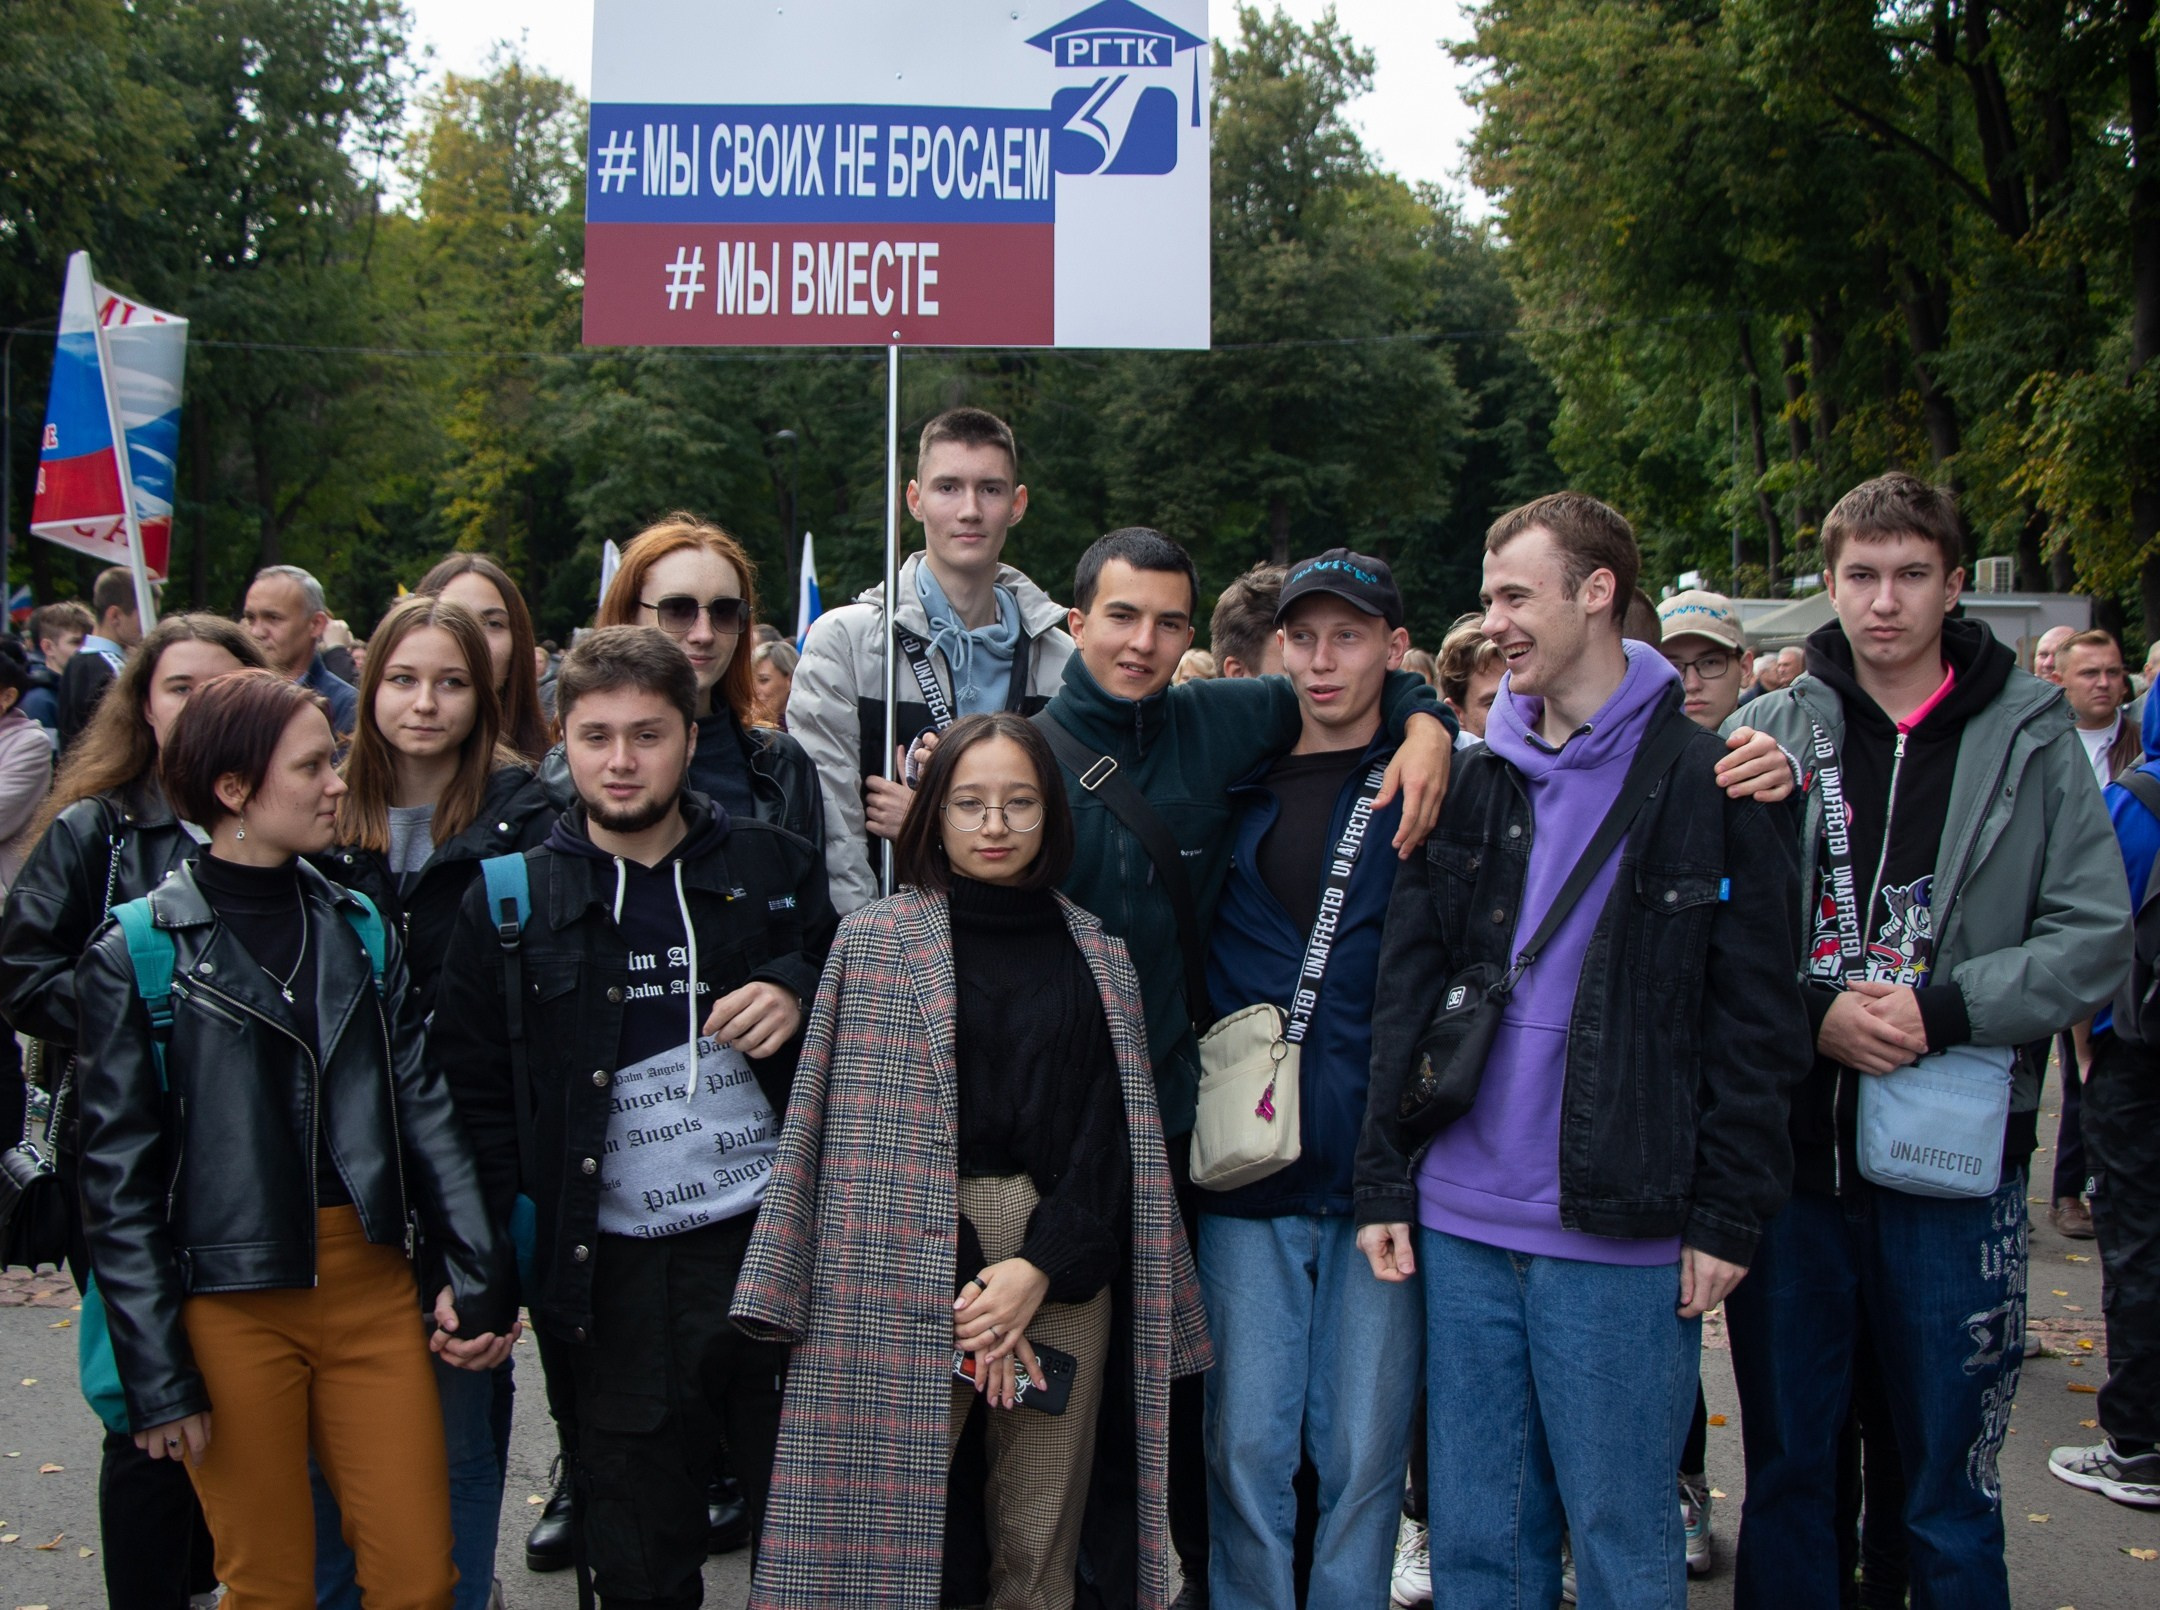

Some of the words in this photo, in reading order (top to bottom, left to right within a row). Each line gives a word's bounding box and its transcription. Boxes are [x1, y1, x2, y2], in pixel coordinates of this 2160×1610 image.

[1066, 37, 1160, 66] РГТК
[710, 123, 826, 198] СВОИХ
[835, 124, 877, 197] НЕ
[887, 127, 1051, 200] БРОСАЕМ
[716, 242, 780, 315] МЫ
[791, 240, 940, 316] ВМЕСТЕ
[912, 659, 953, 730] UNAFFECTE
[1819, 766, 1849, 857] UNAFFECTED
[1832, 865, 1861, 958] UNAFFECTED
[1304, 887, 1345, 979] UNAFFECTED
[628, 950, 657, 971] lm
[613, 1072, 643, 1087] Palm
[647, 1062, 686, 1079] Angels
[704, 1069, 753, 1095] Palm
[609, 1083, 687, 1115] Angels
[627, 1117, 703, 1149] Angels
[713, 1125, 766, 1155] Palm
[1890, 1139, 1983, 1176] UNAFFECTED
[642, 1181, 707, 1213] Palm
[633, 1210, 710, 1238] Angels
